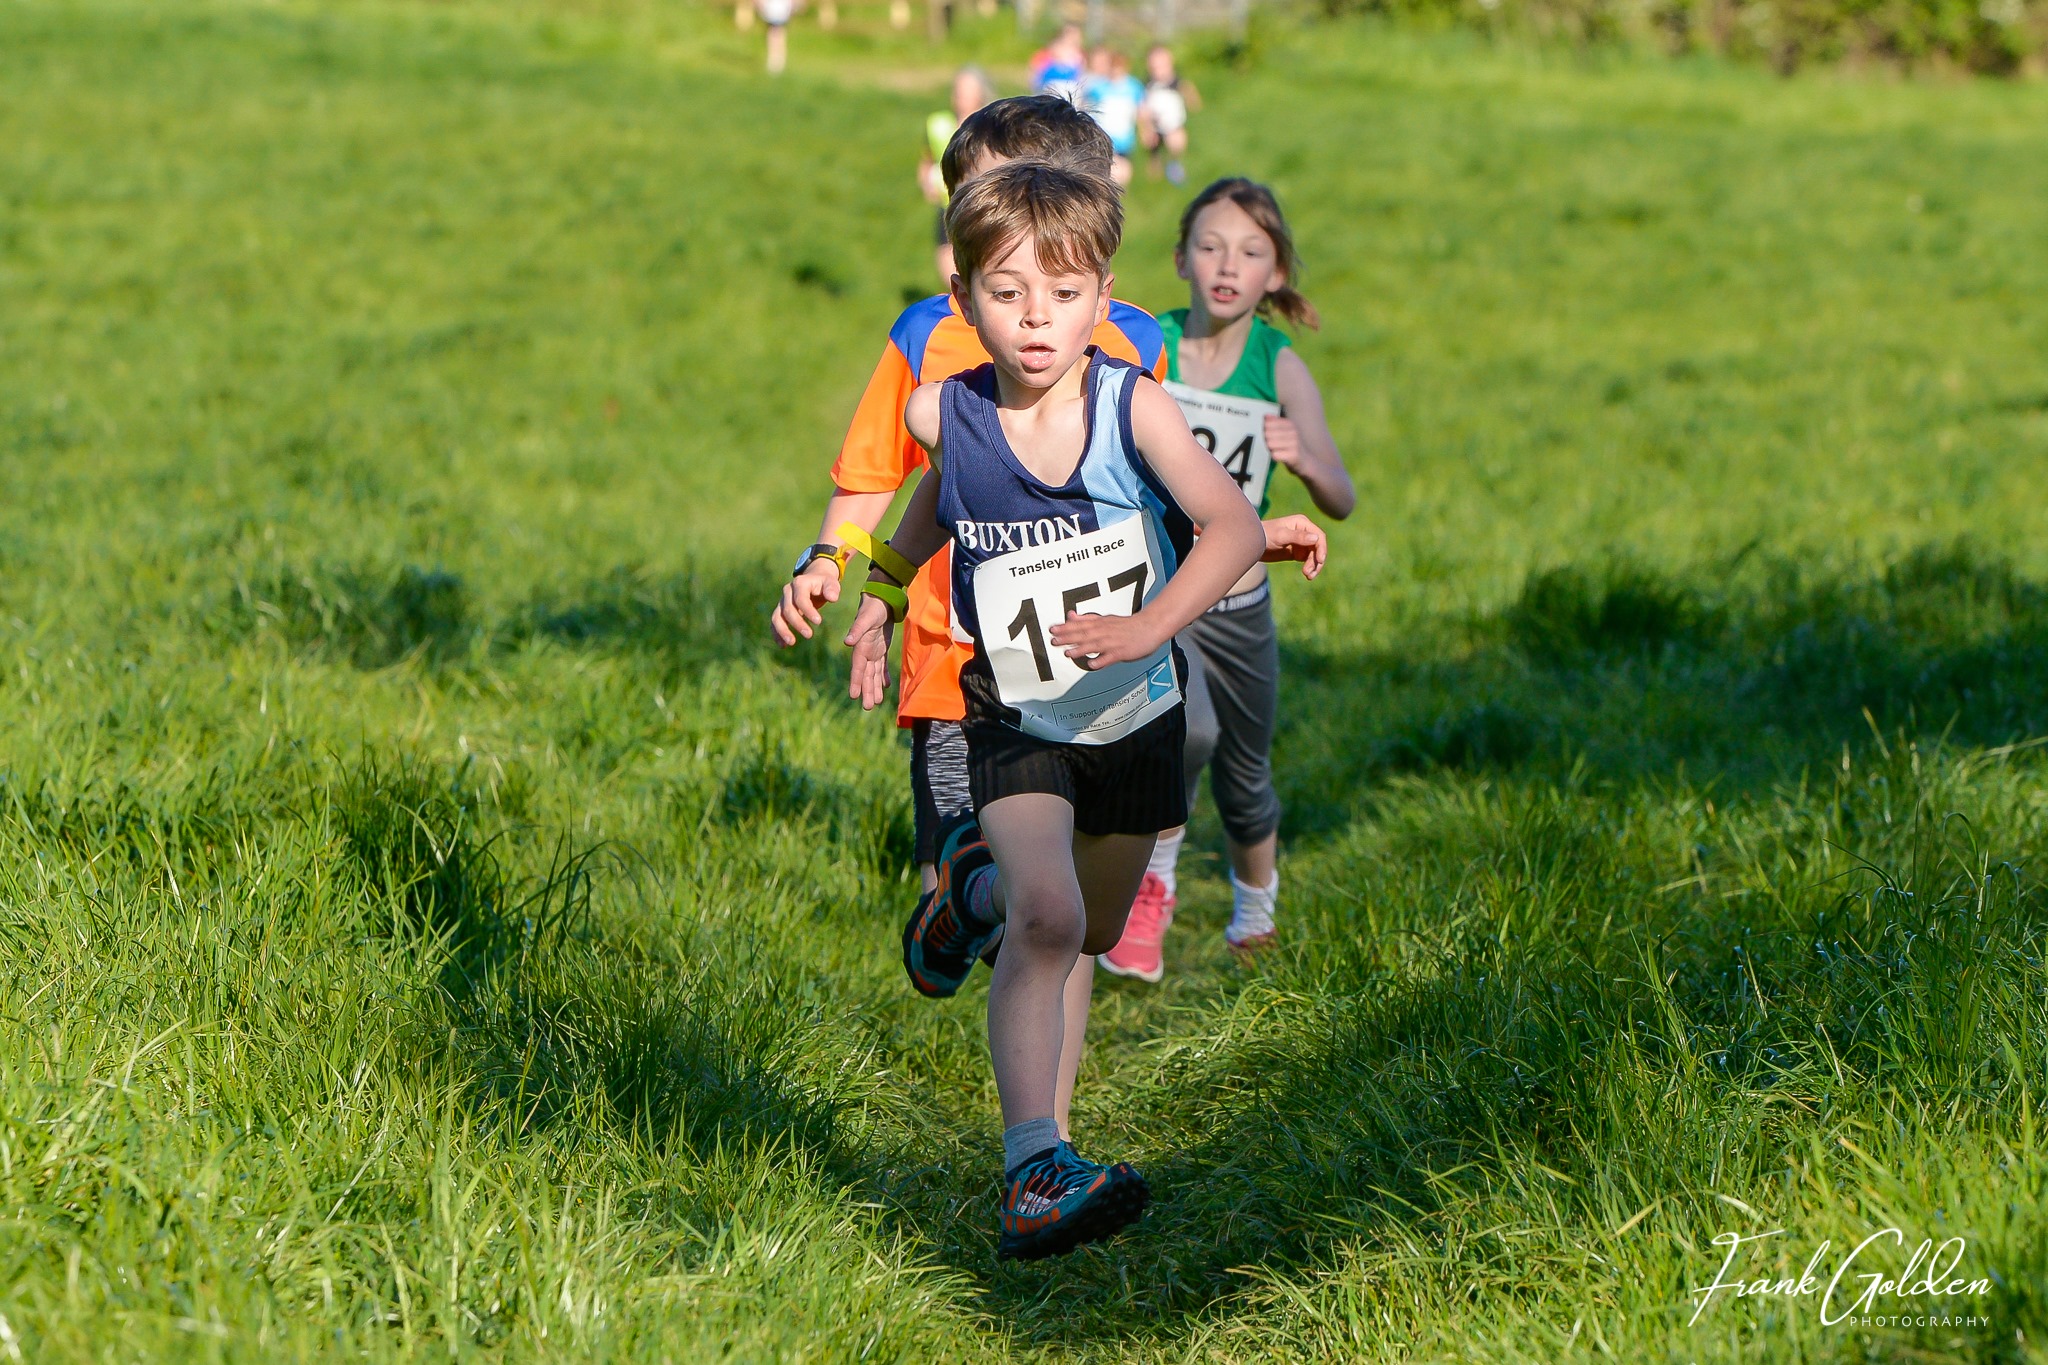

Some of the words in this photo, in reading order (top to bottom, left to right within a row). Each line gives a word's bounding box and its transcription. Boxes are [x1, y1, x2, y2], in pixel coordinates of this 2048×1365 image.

[955, 513, 1083, 552] BUXTON
[1009, 555, 1062, 578] Tansley
[1067, 547, 1090, 564] Hill
[1094, 538, 1125, 556] Race
[1069, 709, 1097, 720] Support
[1099, 705, 1106, 713] of
[1107, 697, 1130, 711] Tansley
[1131, 685, 1146, 700] School
